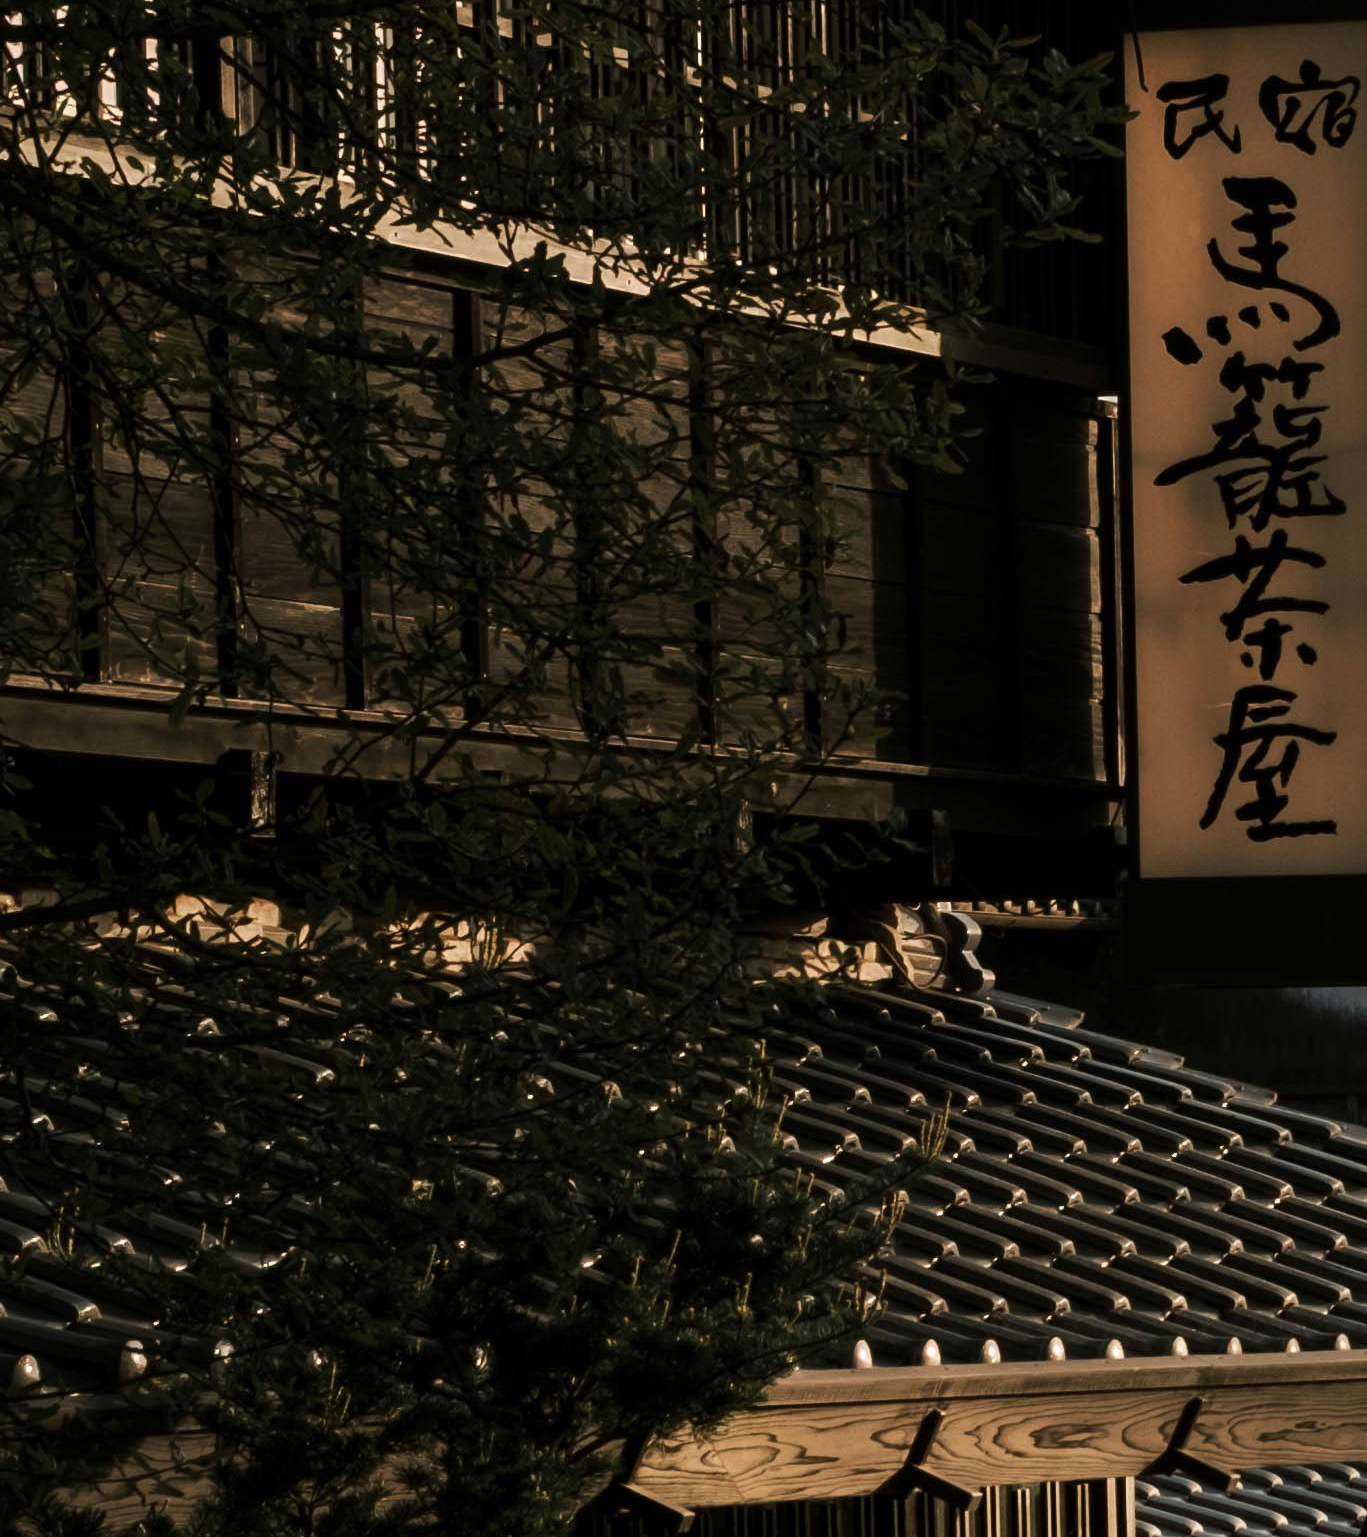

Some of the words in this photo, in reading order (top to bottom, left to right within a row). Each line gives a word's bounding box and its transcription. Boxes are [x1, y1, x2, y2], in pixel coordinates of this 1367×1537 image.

[1156, 58, 1362, 159] 民宿
[1153, 175, 1348, 842] 馬籠茶屋
